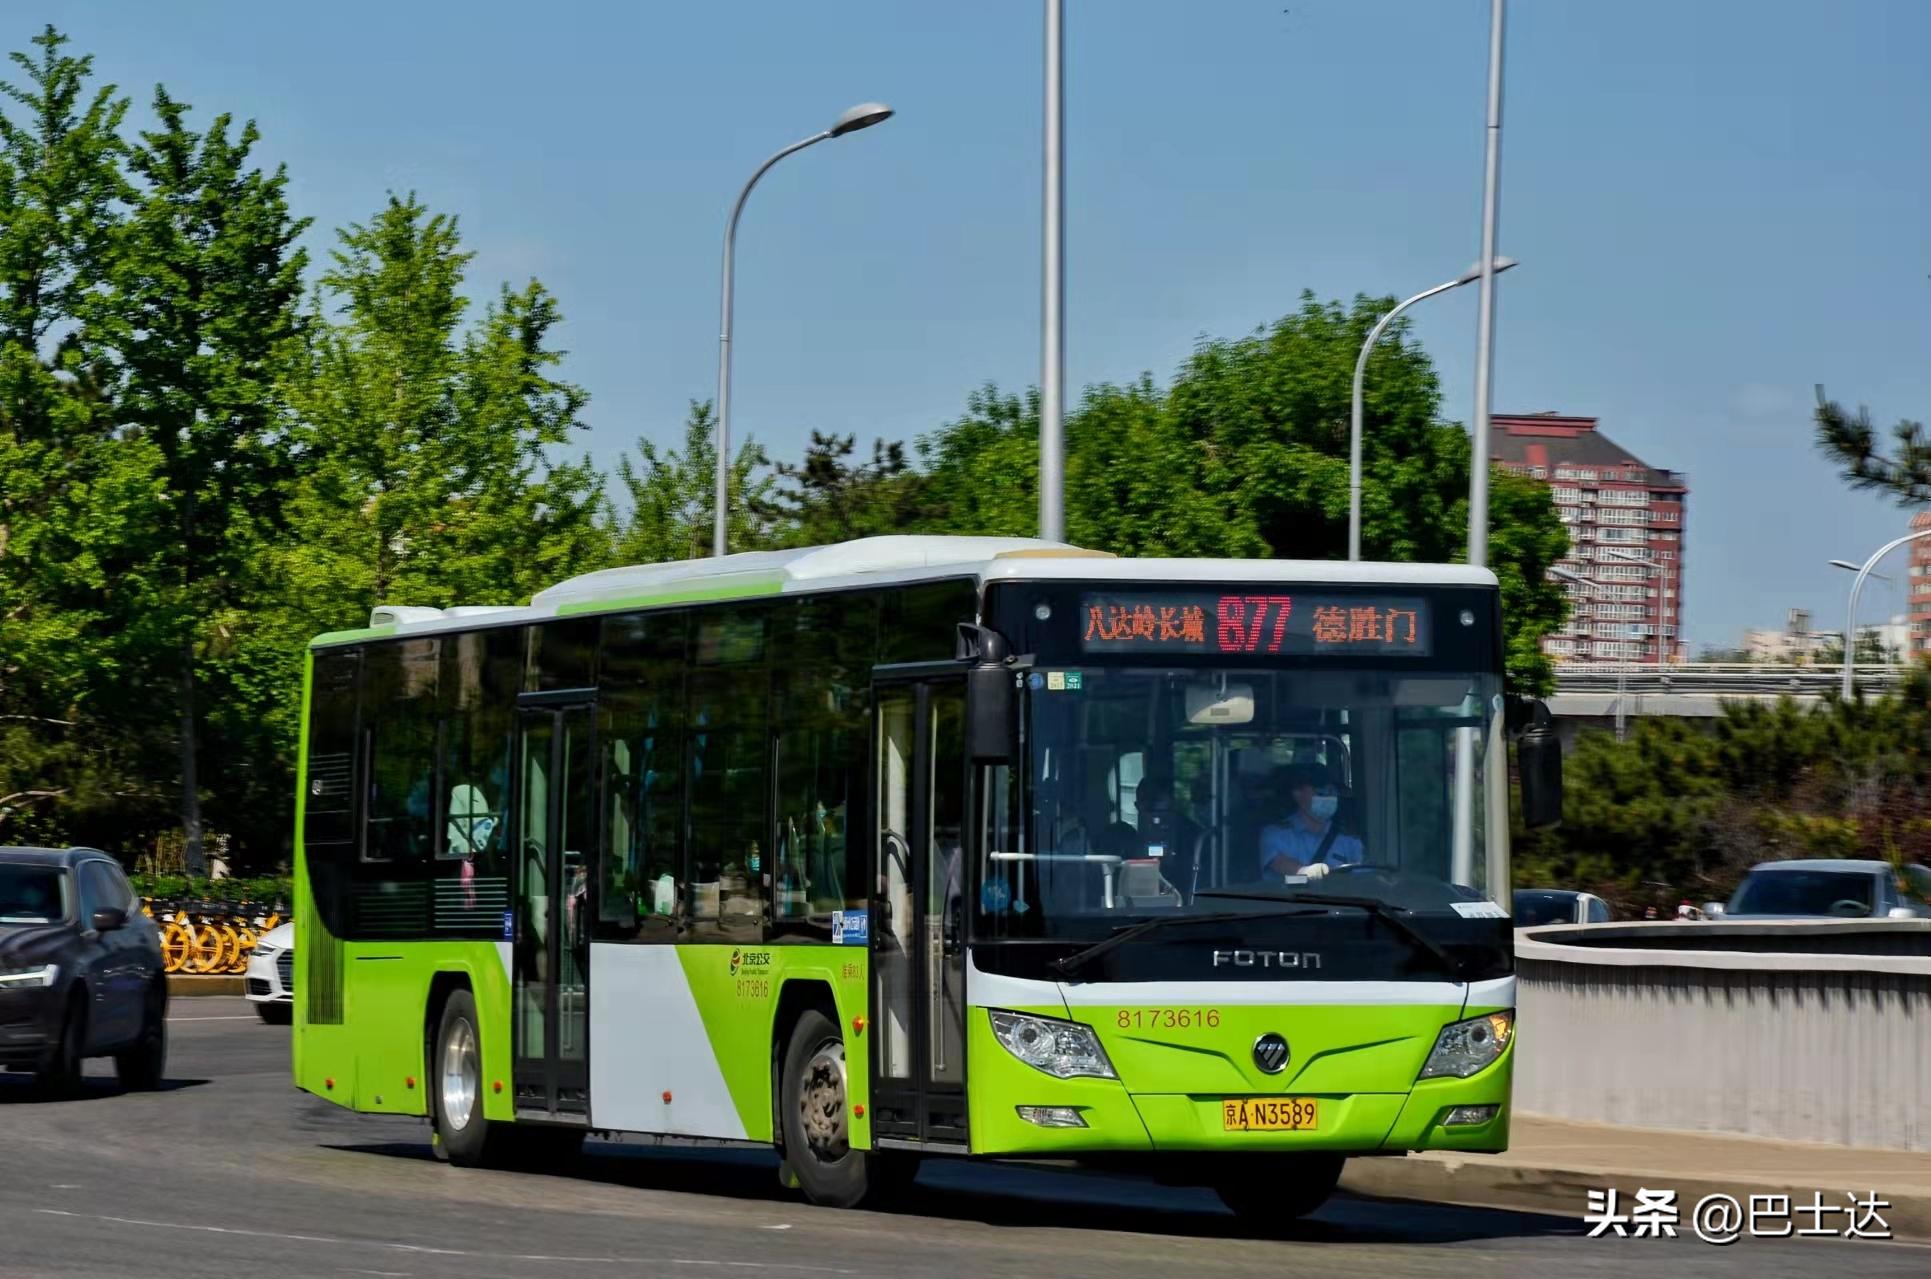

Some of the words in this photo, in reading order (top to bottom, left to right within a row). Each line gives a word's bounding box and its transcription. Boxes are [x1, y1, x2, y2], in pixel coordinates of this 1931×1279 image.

[1216, 596, 1292, 653] 877
[1312, 606, 1417, 643] 德胜门
[742, 952, 770, 966] 北京公交
[1213, 950, 1321, 969] FOTON
[736, 980, 769, 998] 8173616
[1117, 1009, 1220, 1029] 8173616
